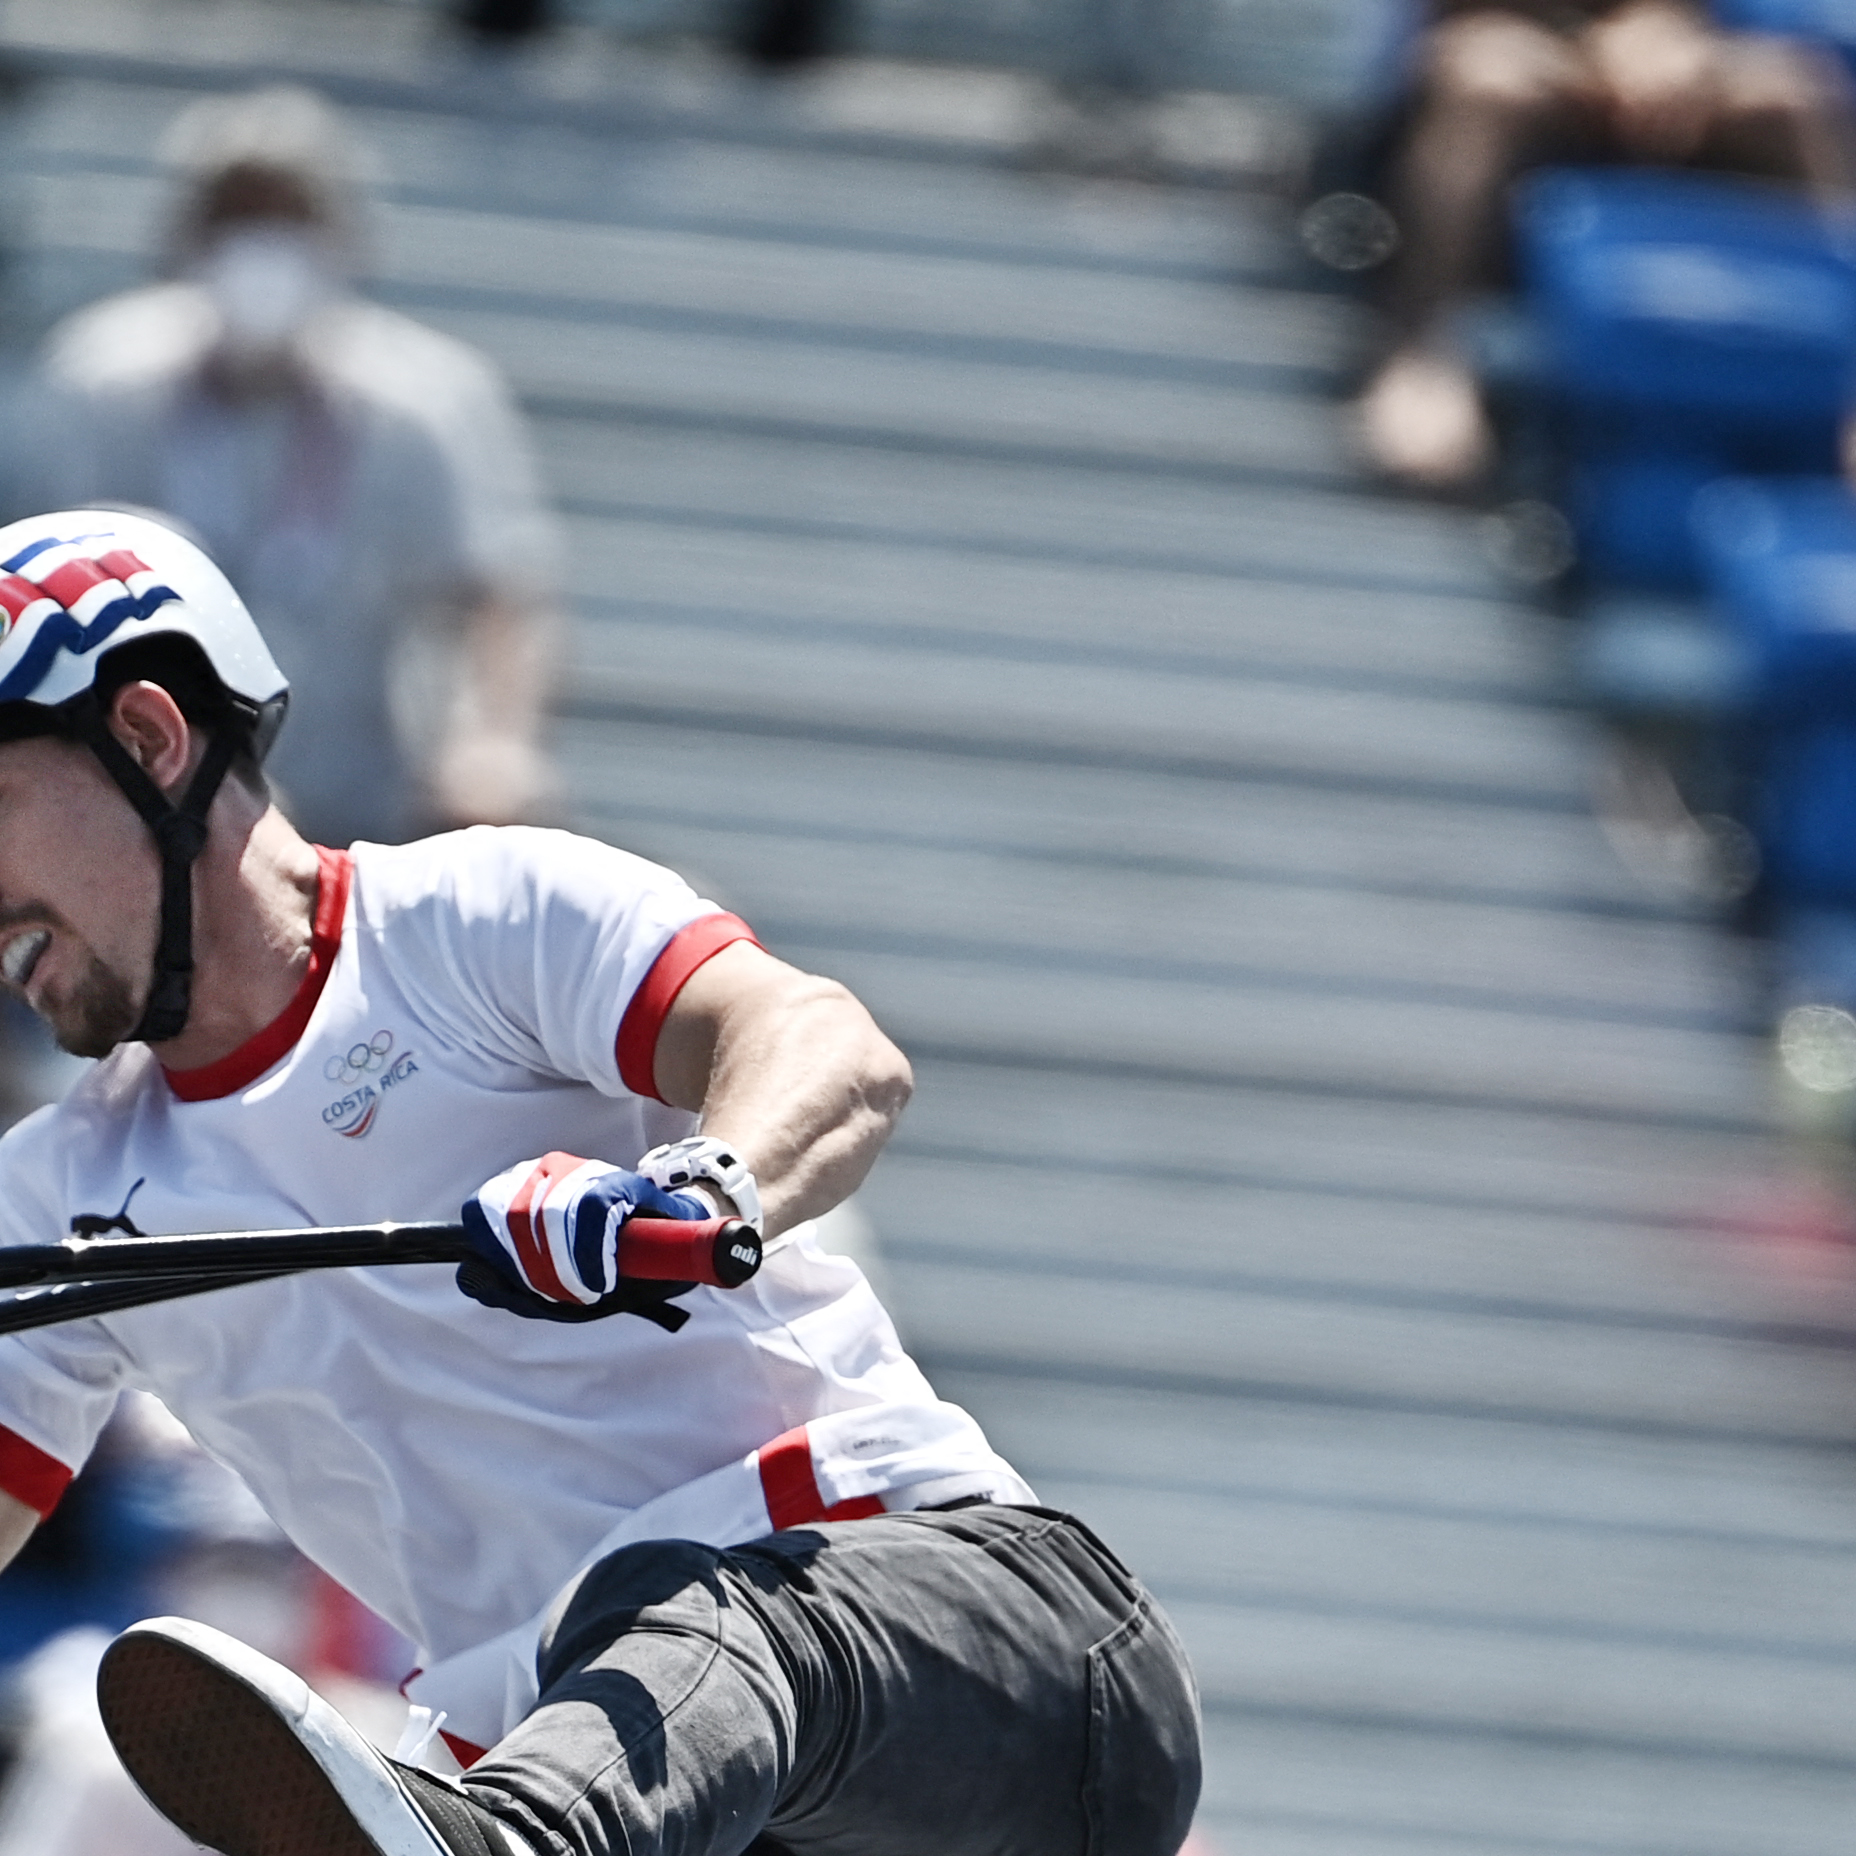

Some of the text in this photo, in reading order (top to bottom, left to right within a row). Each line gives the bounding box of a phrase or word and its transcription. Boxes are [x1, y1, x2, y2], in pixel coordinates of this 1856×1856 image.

[322, 1061, 419, 1124] COSTA RICA
[730, 1243, 758, 1266] odi
